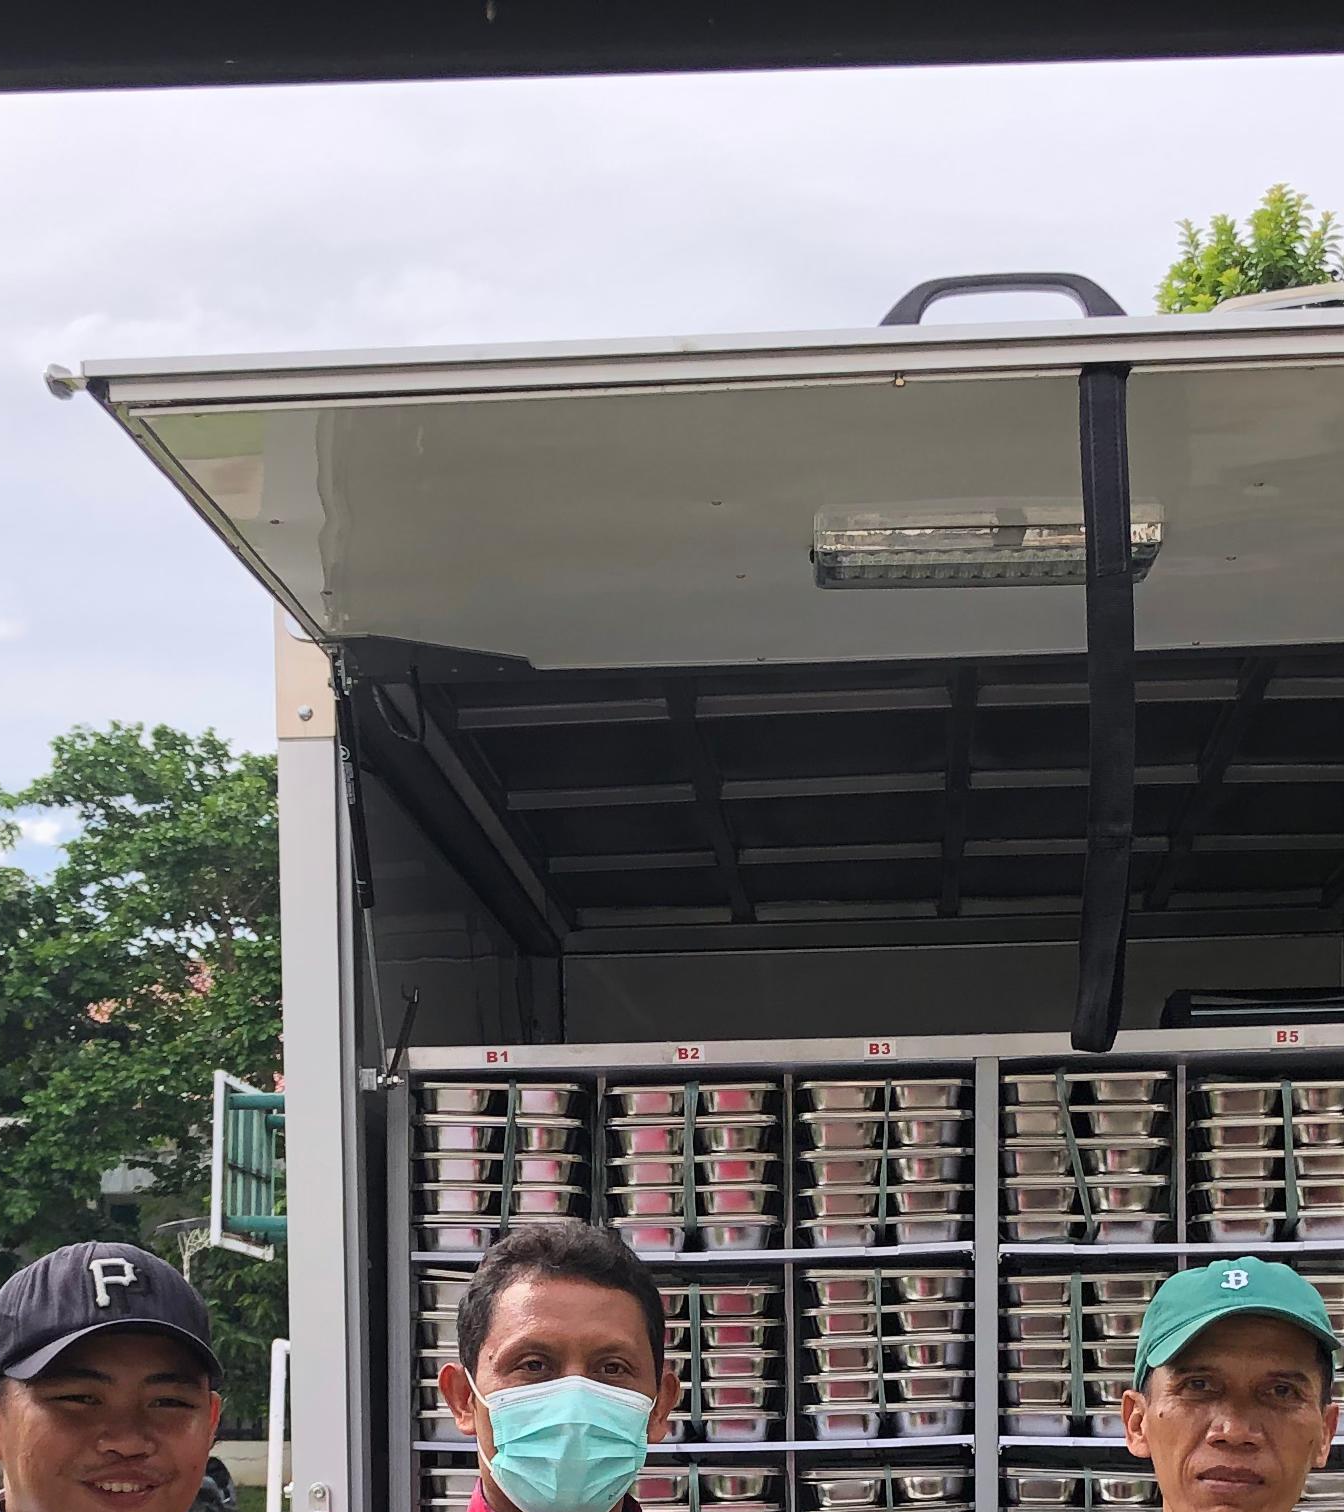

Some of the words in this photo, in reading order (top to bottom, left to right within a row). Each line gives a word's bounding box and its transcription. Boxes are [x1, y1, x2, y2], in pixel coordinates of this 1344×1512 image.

[1276, 1030, 1299, 1043] B5
[677, 1047, 700, 1060] B2
[869, 1042, 891, 1055] B3
[486, 1050, 509, 1063] B1
[89, 1257, 138, 1307] P
[1220, 1269, 1249, 1291] B
